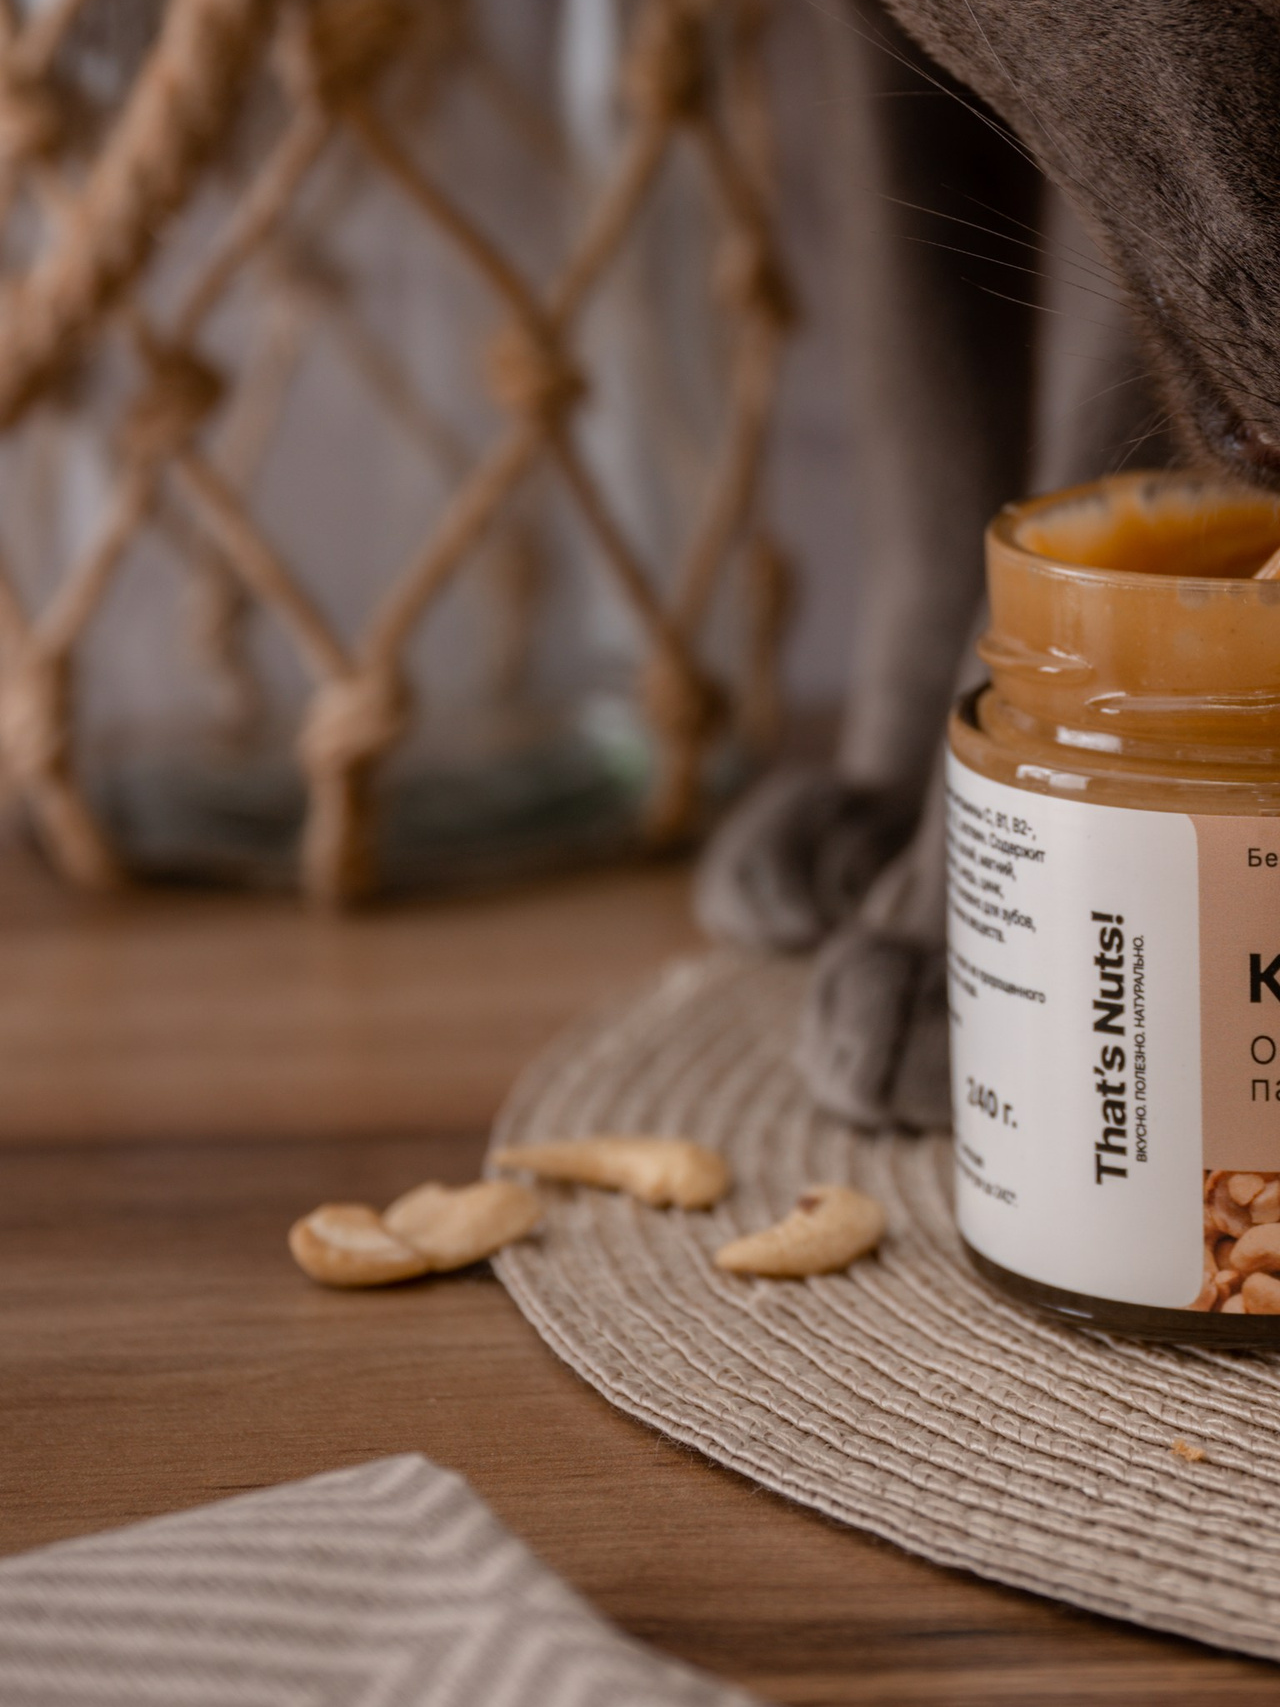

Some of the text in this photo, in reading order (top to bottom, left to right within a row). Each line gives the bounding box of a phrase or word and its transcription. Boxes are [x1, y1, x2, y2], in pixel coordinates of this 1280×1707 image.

[1090, 910, 1126, 1037] Nuts!
[1132, 934, 1148, 1163] ВКУСНО. ПОЛЕЗНО. НАТУРАЛЬНО.
[1003, 1102, 1018, 1129] г.
